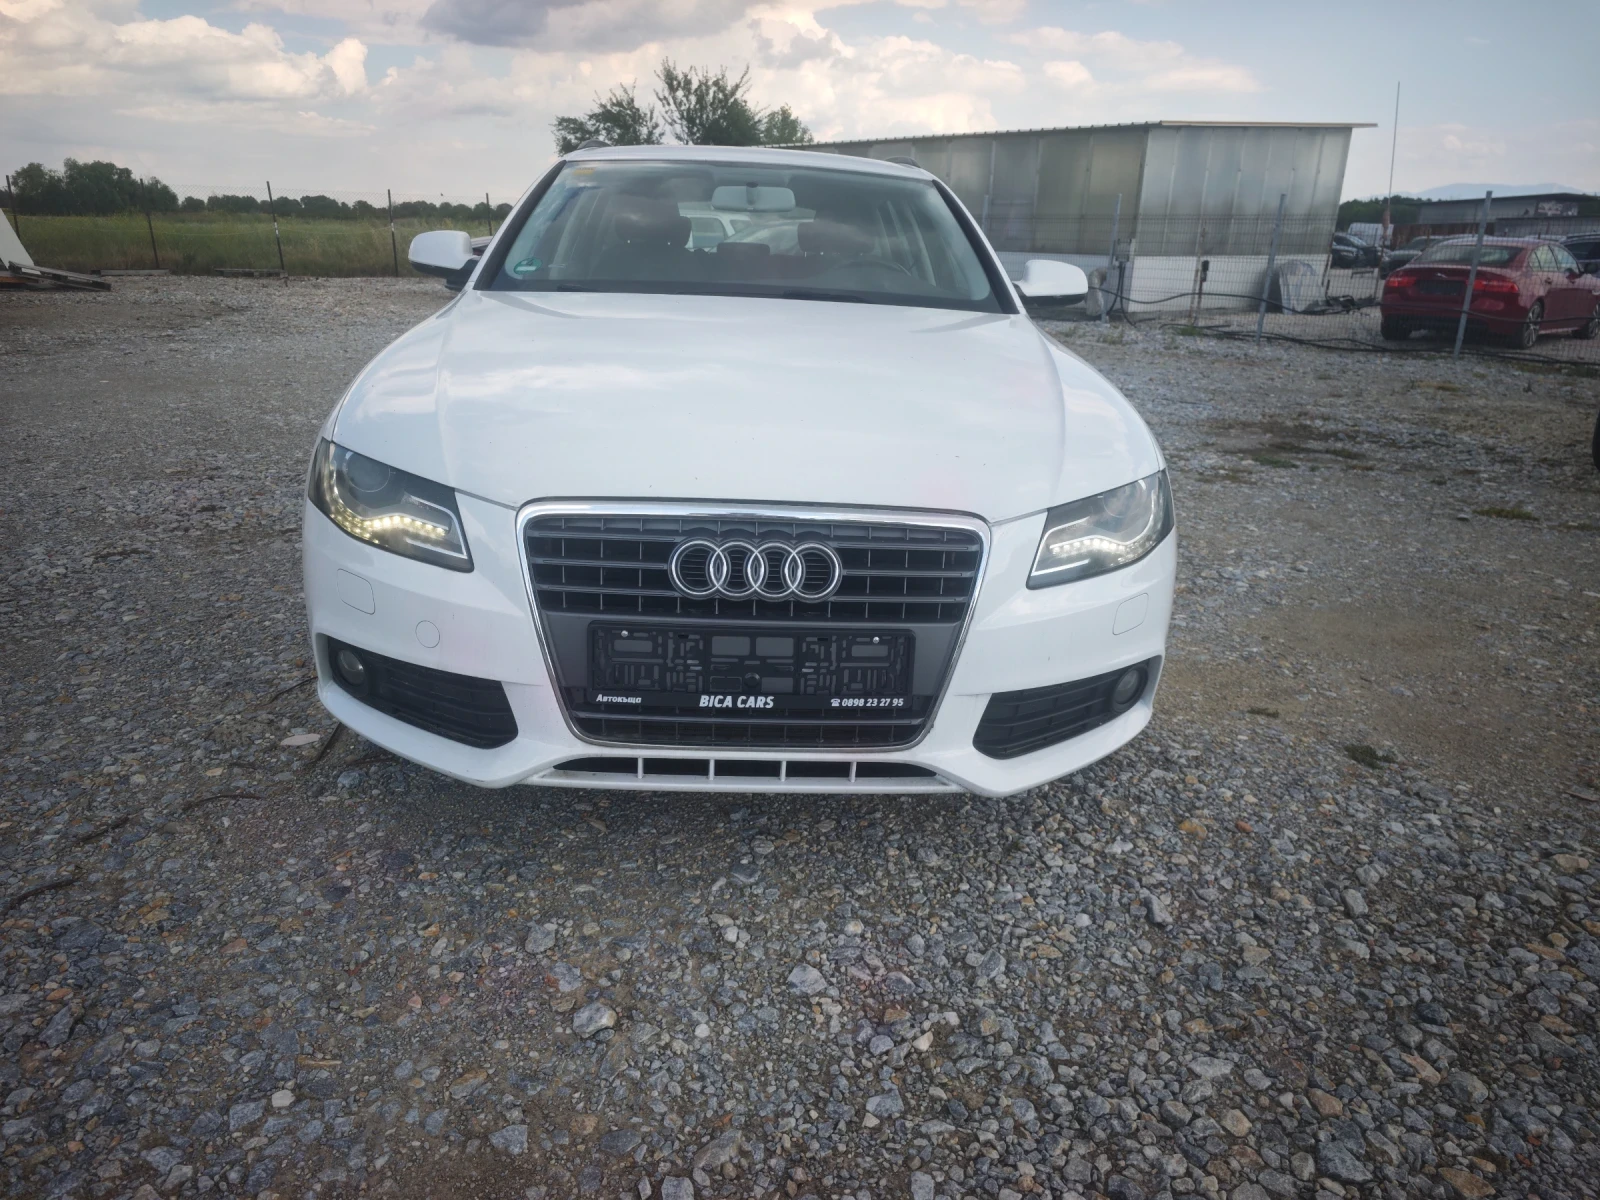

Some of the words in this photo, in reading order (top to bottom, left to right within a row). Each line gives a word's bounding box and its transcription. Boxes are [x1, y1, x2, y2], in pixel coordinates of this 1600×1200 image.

[596, 694, 642, 704] Автокъща
[699, 695, 733, 708] BICA
[737, 696, 774, 709] CARS
[842, 698, 865, 707] 0898
[866, 698, 878, 707] 23
[879, 698, 891, 707] 27
[892, 698, 904, 707] 95
